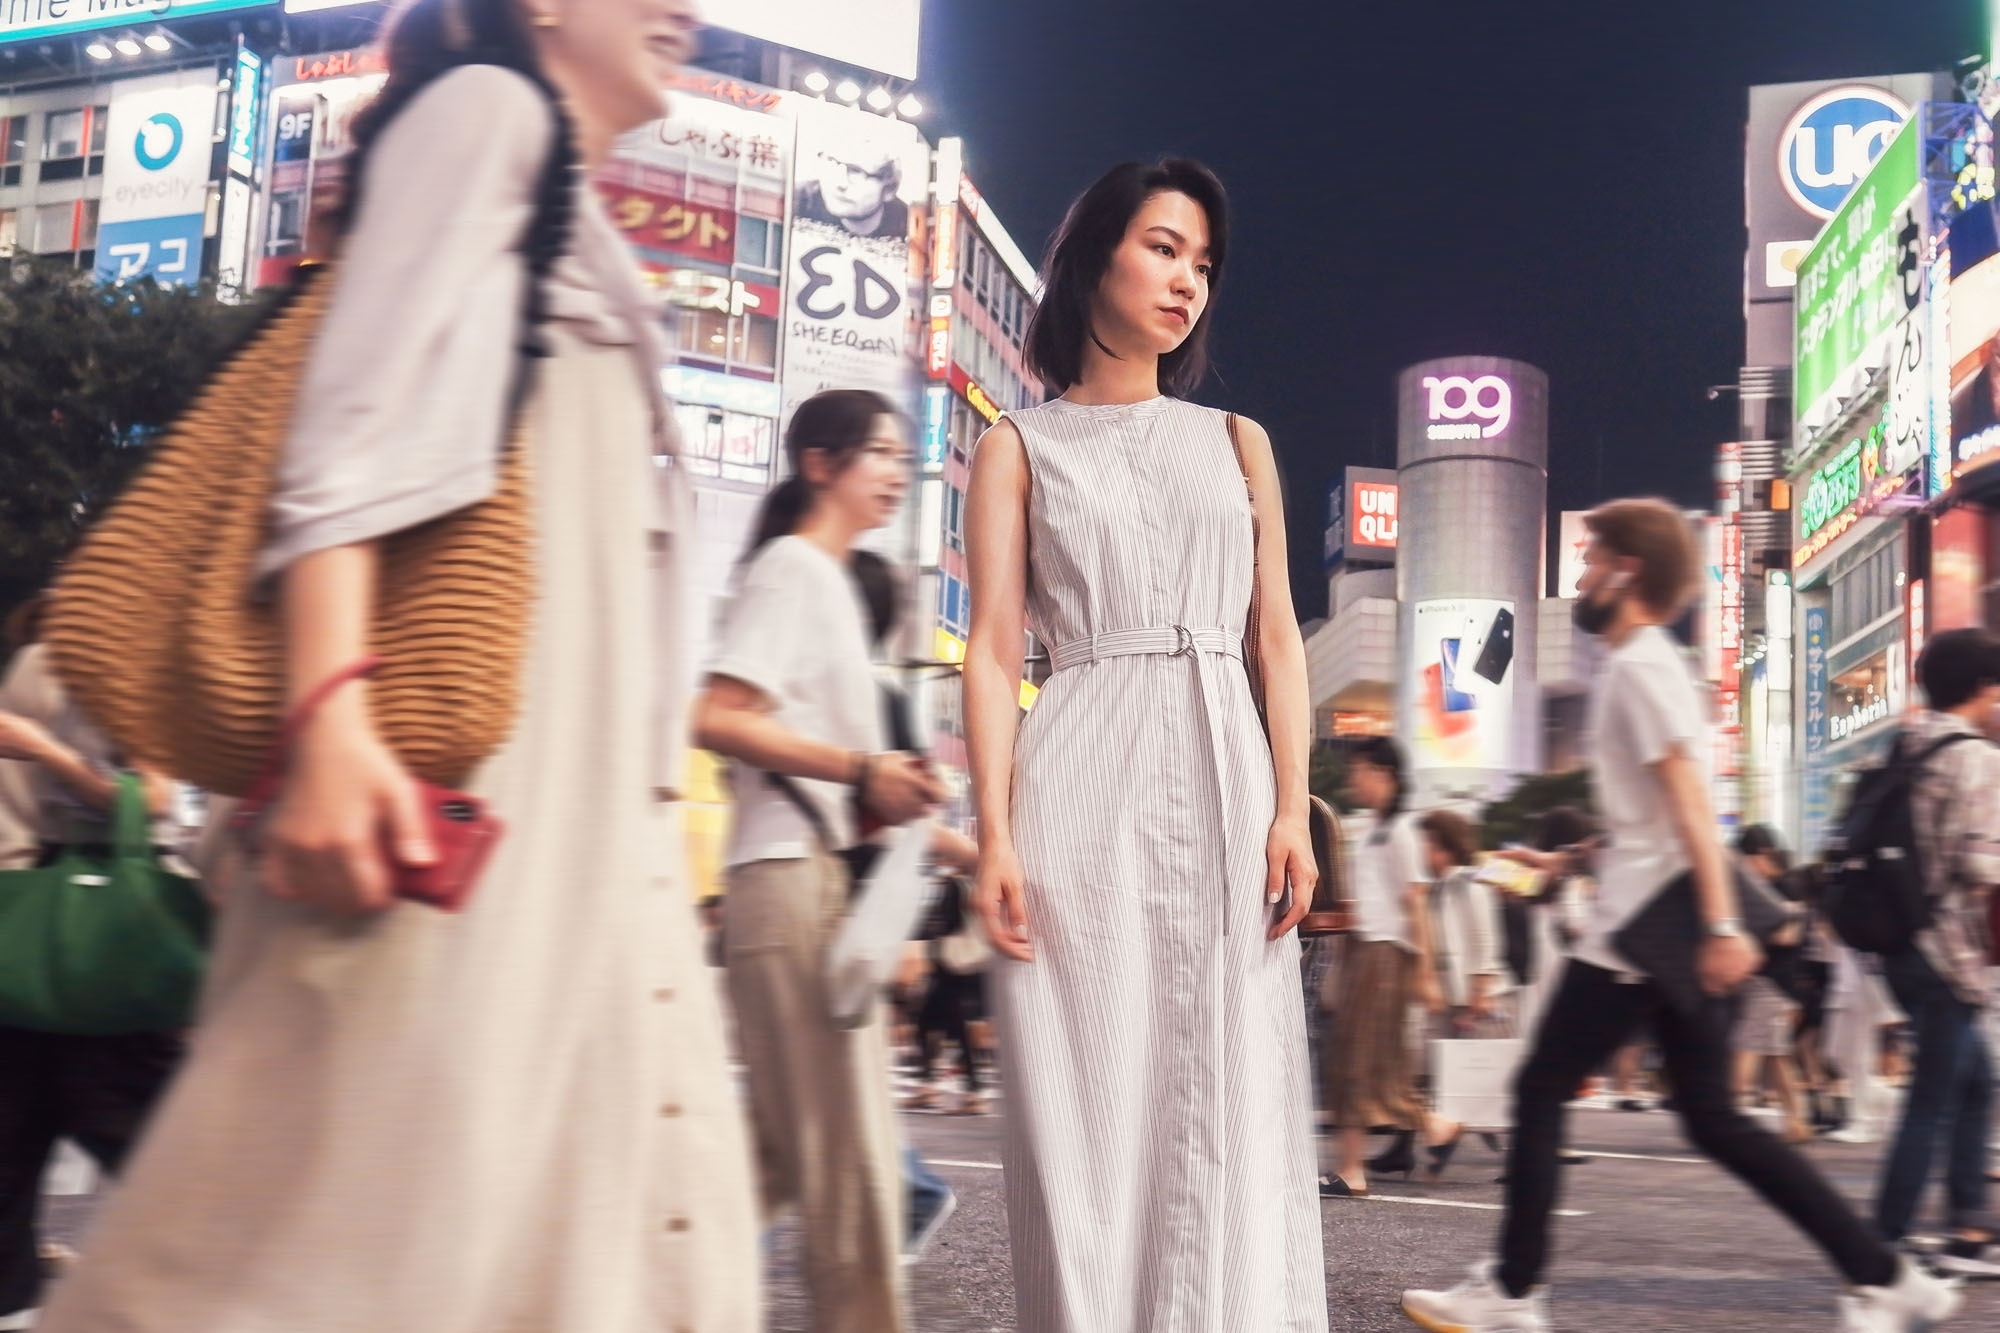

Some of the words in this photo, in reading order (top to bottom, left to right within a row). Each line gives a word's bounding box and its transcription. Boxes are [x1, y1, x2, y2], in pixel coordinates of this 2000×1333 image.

[279, 112, 312, 140] 9F
[115, 178, 192, 206] eyecity
[797, 246, 901, 320] ED
[1423, 375, 1512, 438] 109
